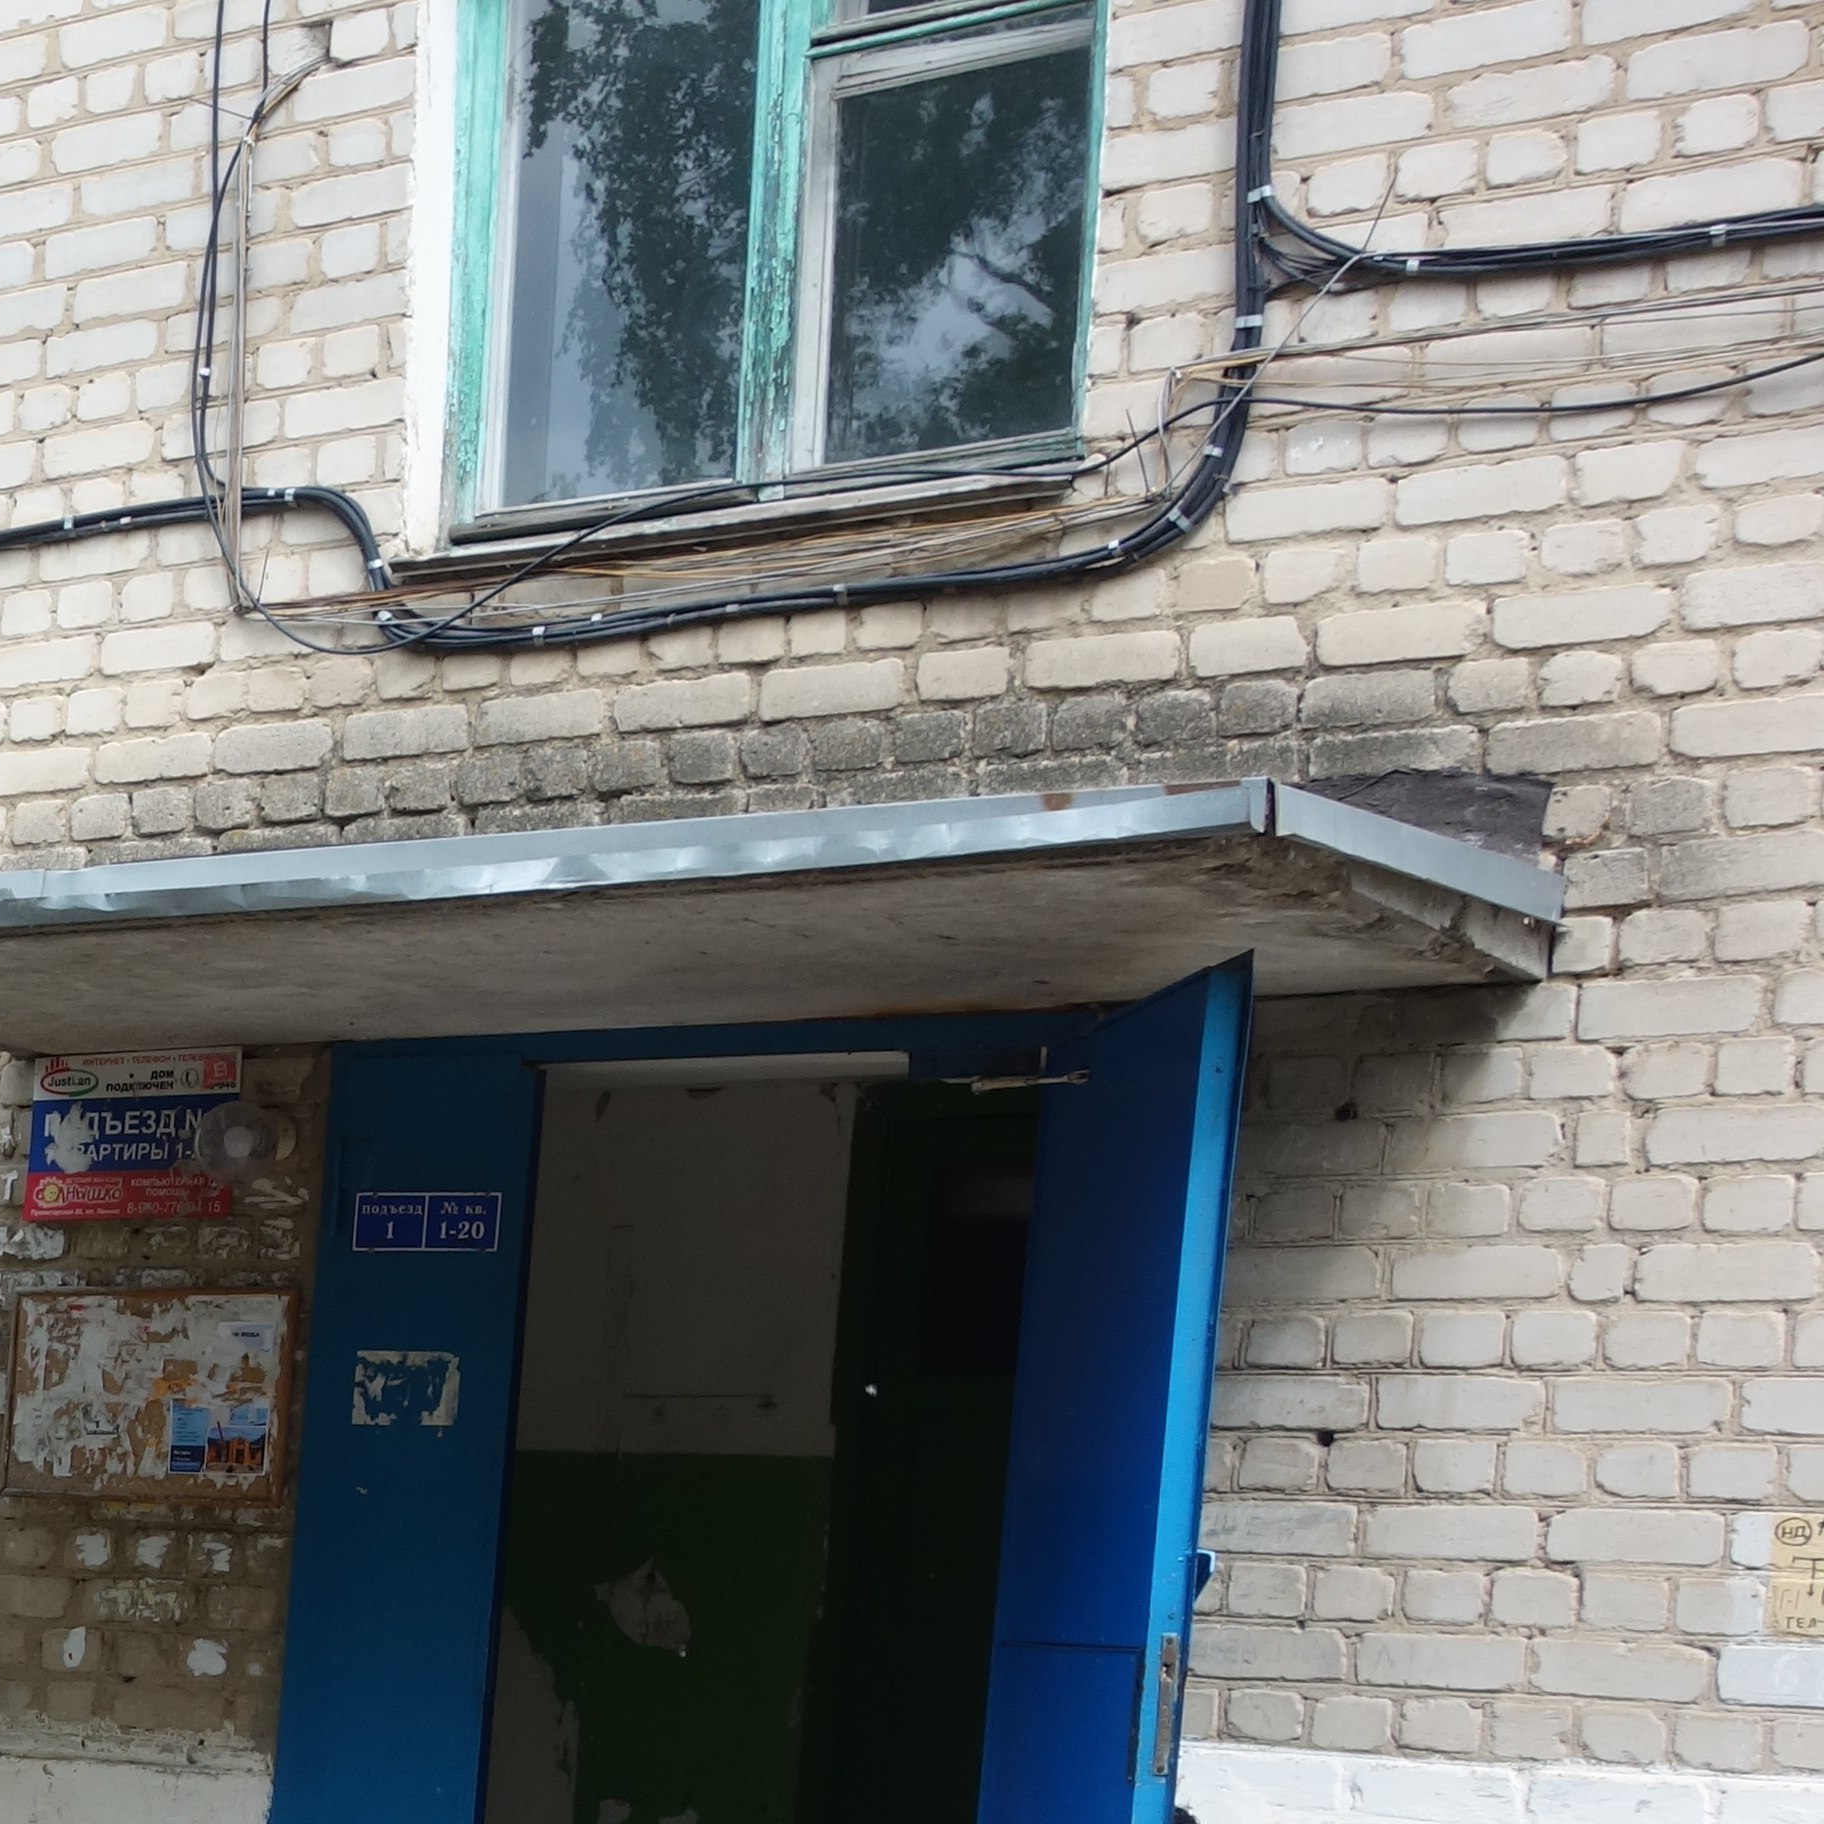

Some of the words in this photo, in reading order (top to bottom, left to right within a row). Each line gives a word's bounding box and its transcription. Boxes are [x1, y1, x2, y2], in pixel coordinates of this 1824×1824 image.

[83, 1057, 125, 1066] ИНТЕРНЕТ
[132, 1055, 171, 1065] ТЕЛЕФОН
[48, 1075, 91, 1088] JustLan
[150, 1070, 174, 1080] ДОМ
[44, 1109, 176, 1139] ПДЪЕЗД
[64, 1142, 169, 1161] ВАРТИРЫ
[361, 1204, 423, 1216] подъезд
[465, 1204, 487, 1215] кв.
[386, 1221, 394, 1239] 1
[440, 1221, 486, 1240] 1-20
